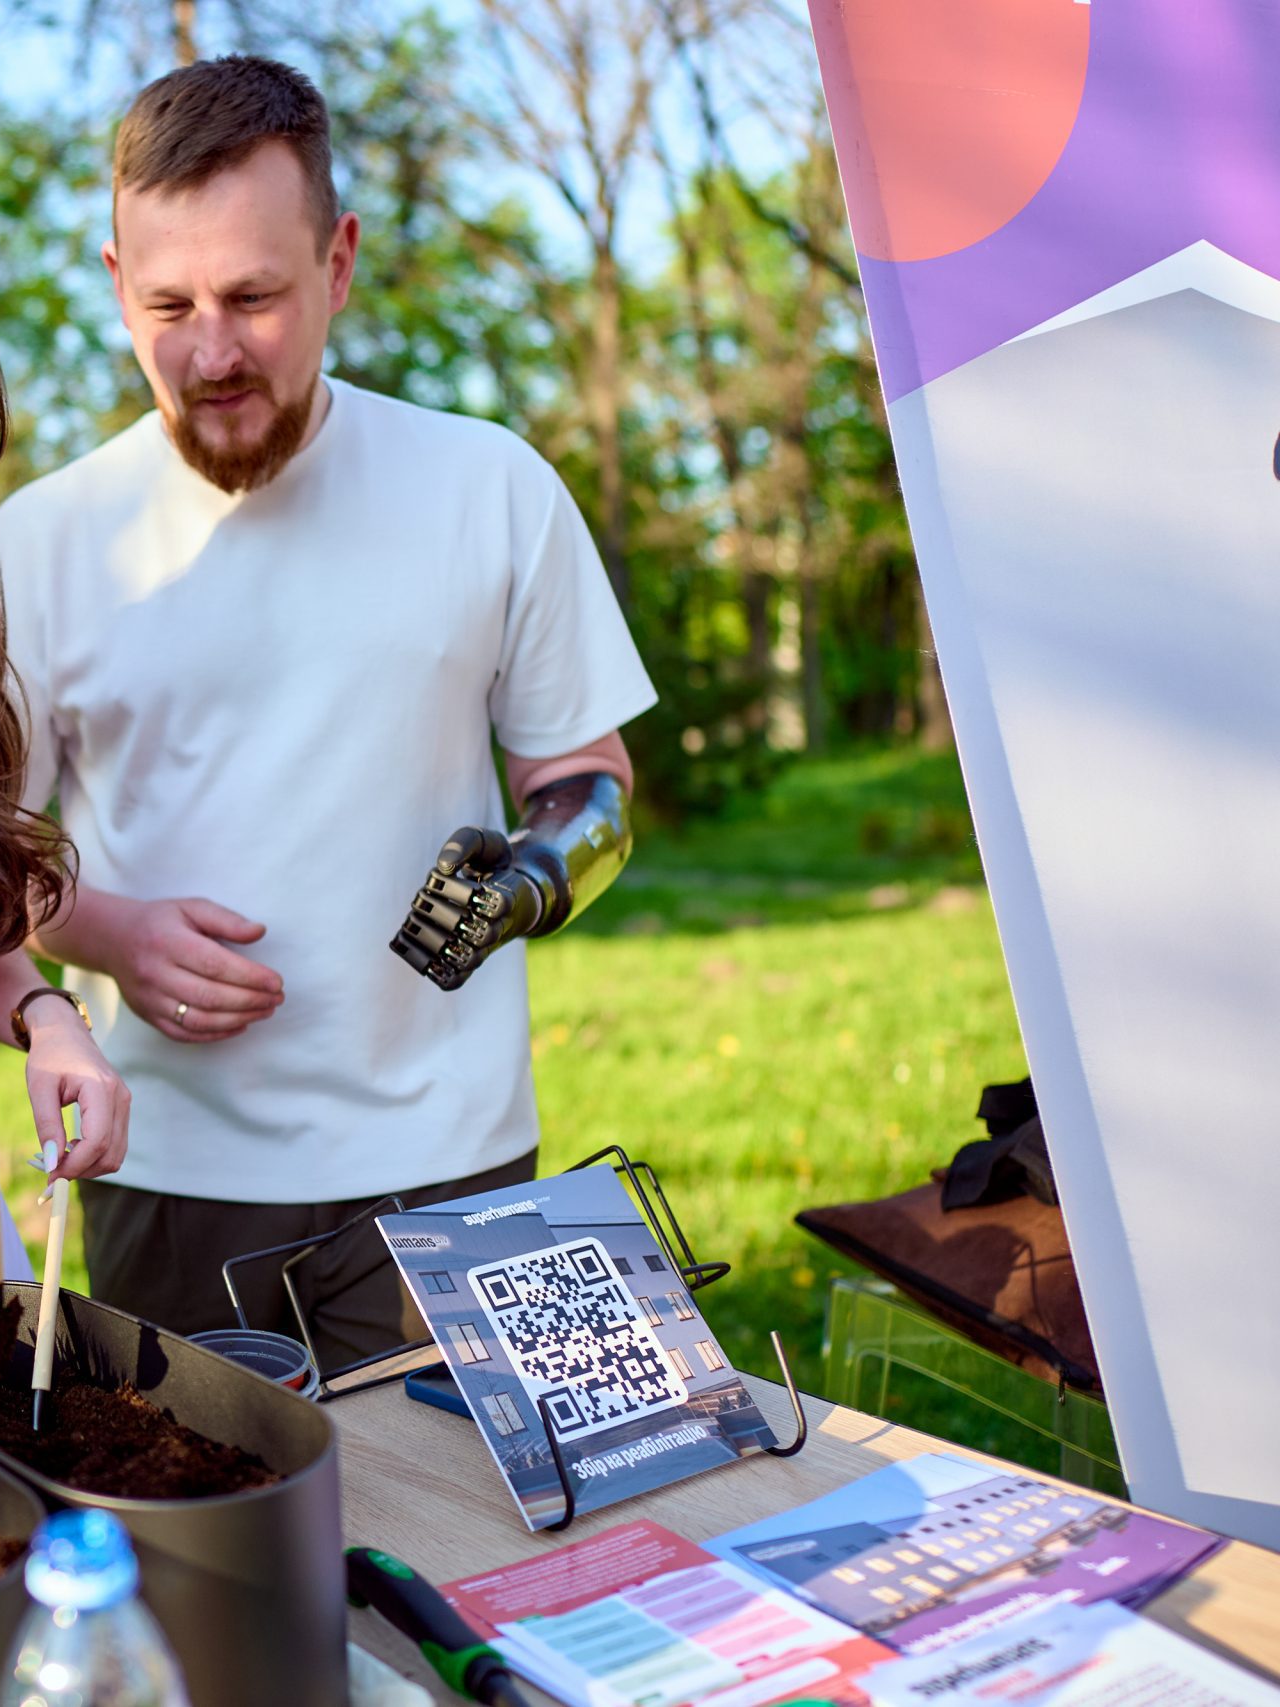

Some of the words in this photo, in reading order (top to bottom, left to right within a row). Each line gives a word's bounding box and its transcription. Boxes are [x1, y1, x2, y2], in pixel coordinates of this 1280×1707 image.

[463, 1199, 537, 1226] superhumans
[571, 1456, 609, 1480] Збір
[603, 1453, 627, 1470] на
[621, 1424, 708, 1468] реабілітацію
